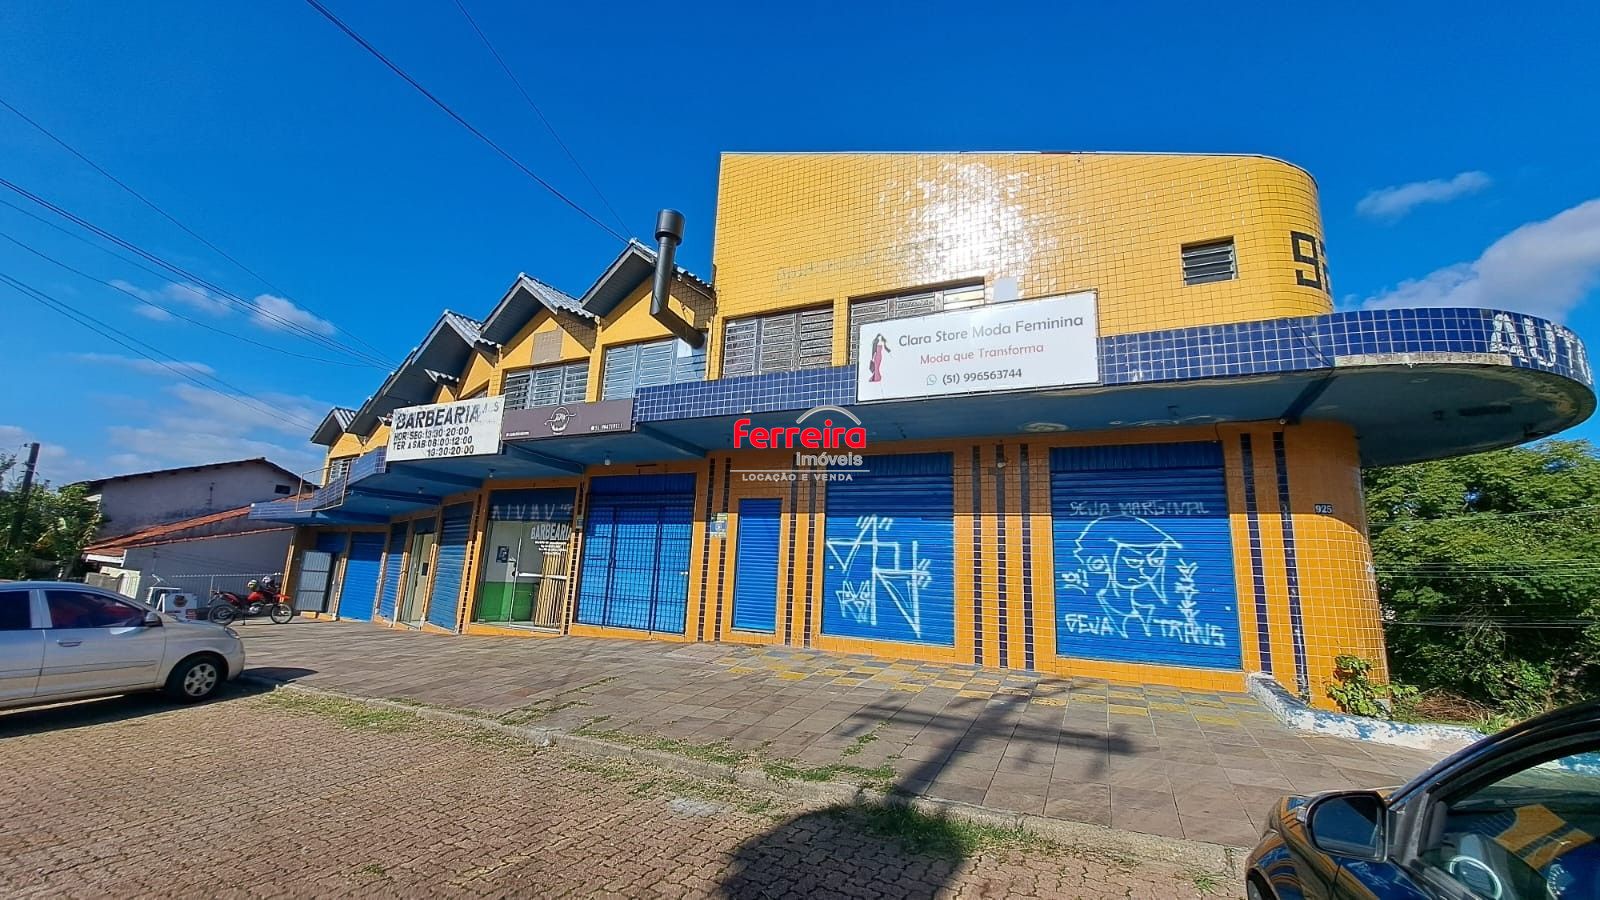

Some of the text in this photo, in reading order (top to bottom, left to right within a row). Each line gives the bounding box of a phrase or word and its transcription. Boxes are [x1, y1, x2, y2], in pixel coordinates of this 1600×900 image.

[899, 315, 1084, 347] Clara Store Moda Feminina
[920, 343, 1044, 366] Moda que Transforma
[942, 368, 1022, 385] (51) 996563744
[395, 404, 480, 430] BARBEARIA
[1315, 505, 1332, 514] 925
